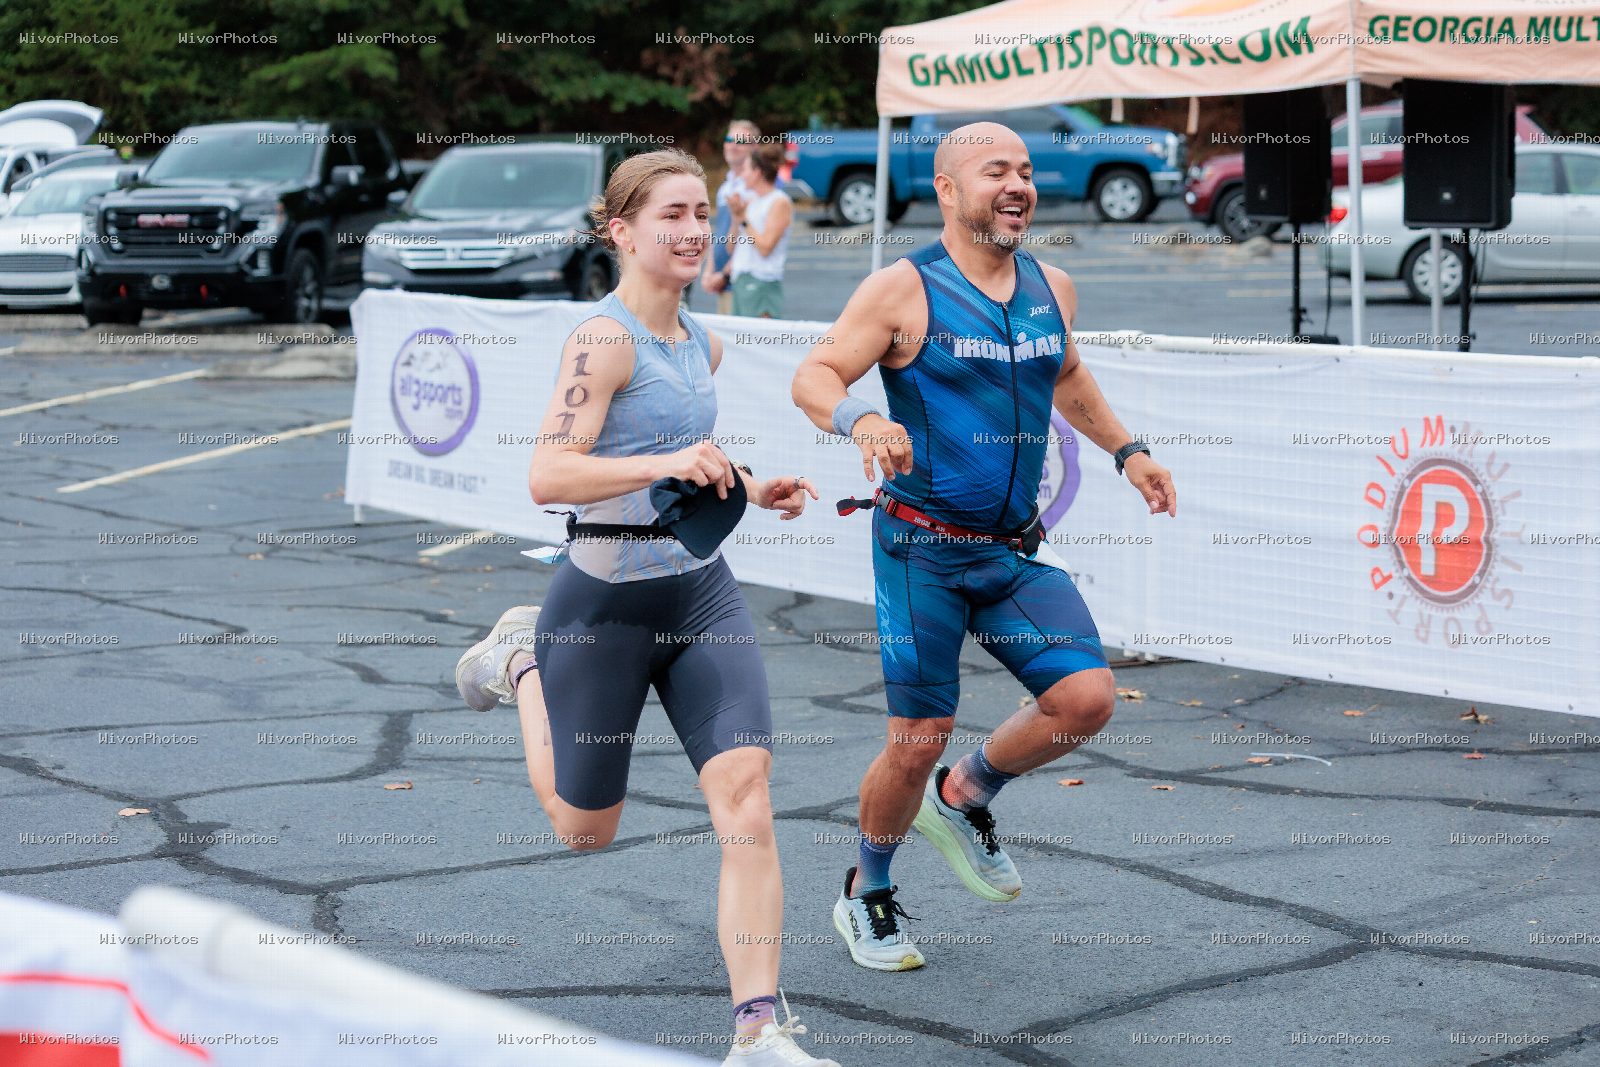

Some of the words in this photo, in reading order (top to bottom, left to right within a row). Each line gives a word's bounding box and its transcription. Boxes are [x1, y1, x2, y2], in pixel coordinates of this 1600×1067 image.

[908, 16, 1316, 86] GAMULTISPORTS.COM
[1368, 15, 1516, 43] GEORGIA
[954, 332, 1063, 362] IRONMAN
[1357, 415, 1446, 591] PODIUM
[1420, 483, 1471, 576] P
